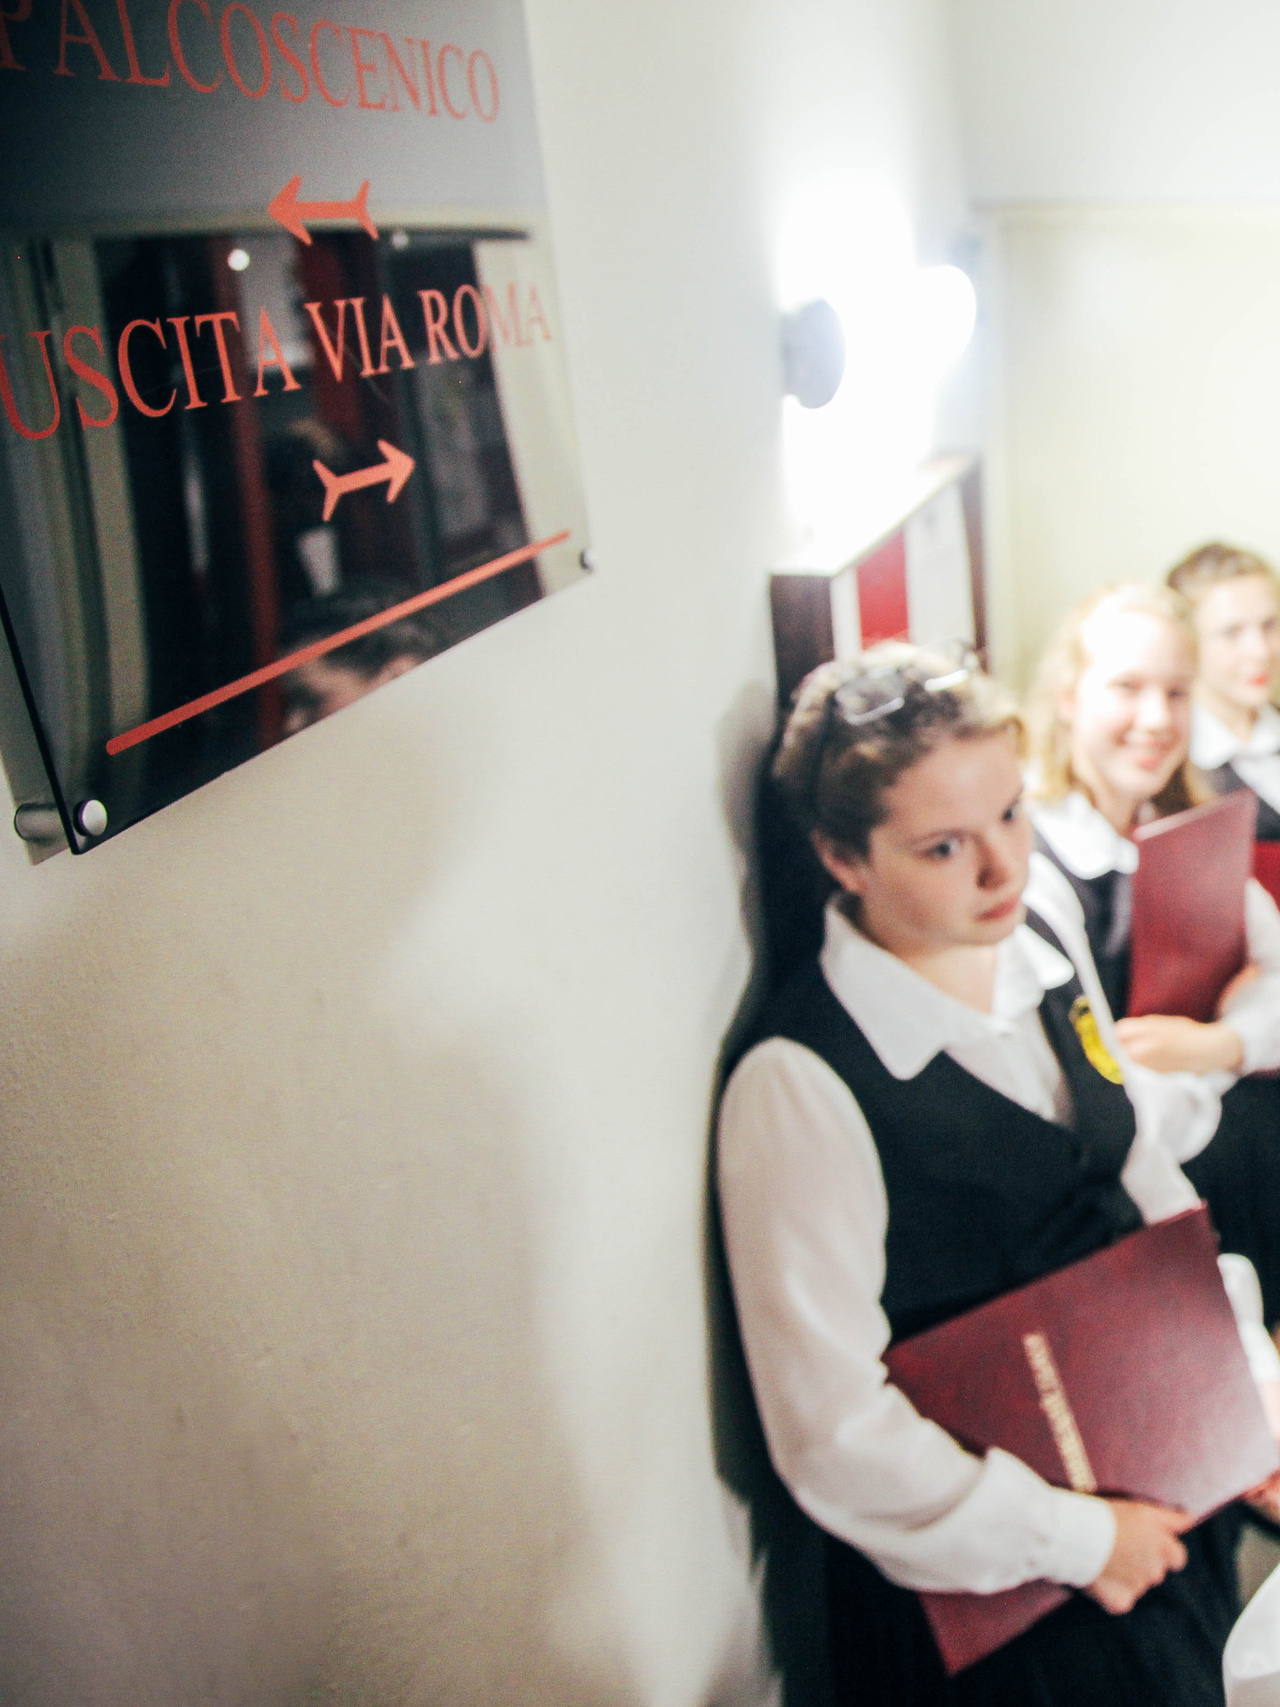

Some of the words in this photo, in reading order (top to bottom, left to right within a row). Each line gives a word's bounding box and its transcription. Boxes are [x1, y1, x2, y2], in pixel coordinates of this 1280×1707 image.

[0, 307, 301, 440] USCITA
[306, 295, 415, 381] VIA
[418, 282, 552, 366] ROMA
